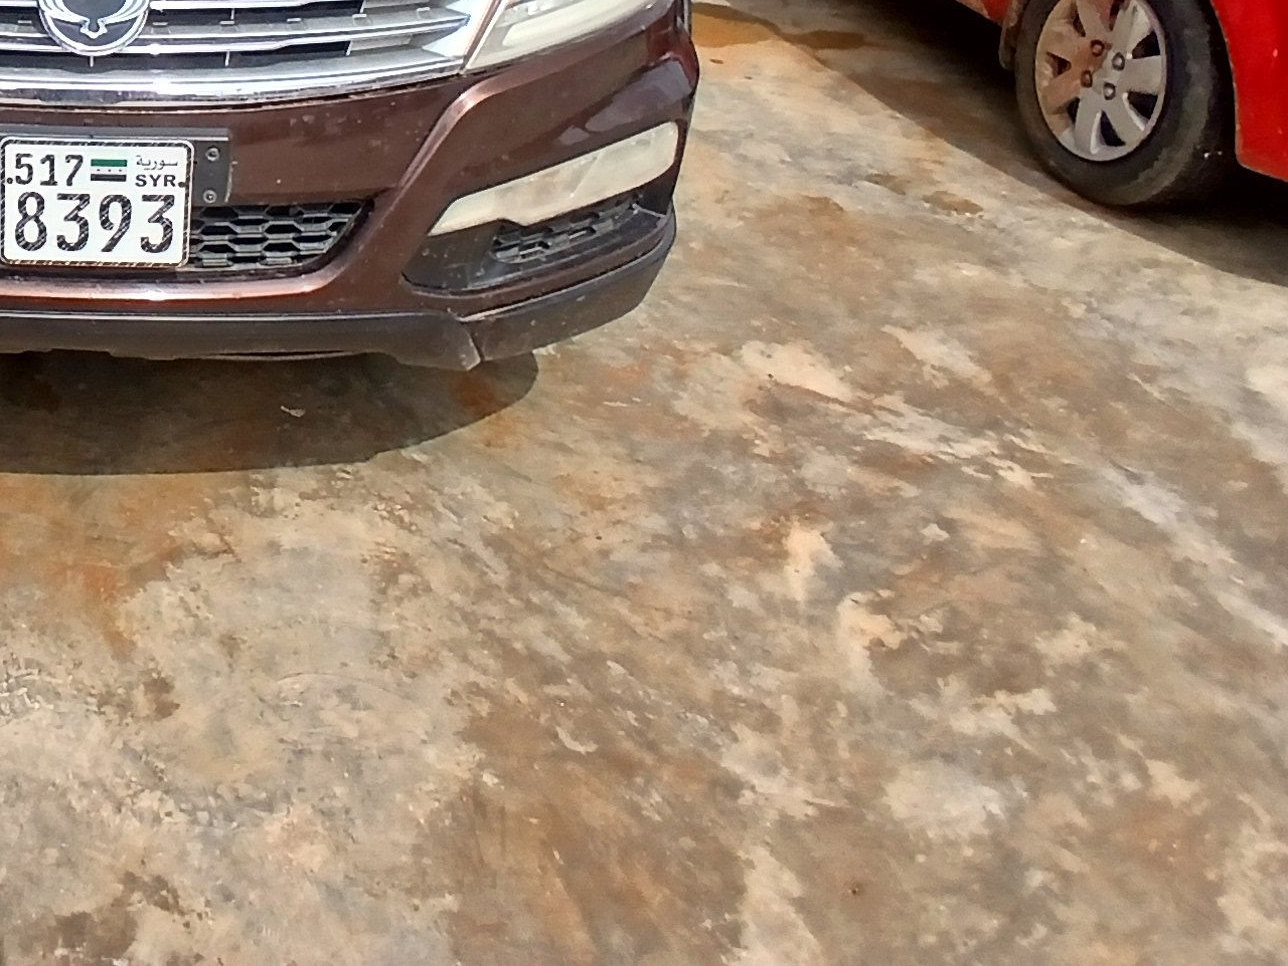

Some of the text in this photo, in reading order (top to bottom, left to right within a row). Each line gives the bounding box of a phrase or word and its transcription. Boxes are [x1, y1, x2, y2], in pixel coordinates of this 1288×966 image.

[15, 153, 84, 186] 517
[135, 154, 179, 171] سورية
[135, 174, 176, 188] SYR
[15, 191, 175, 253] 8393
